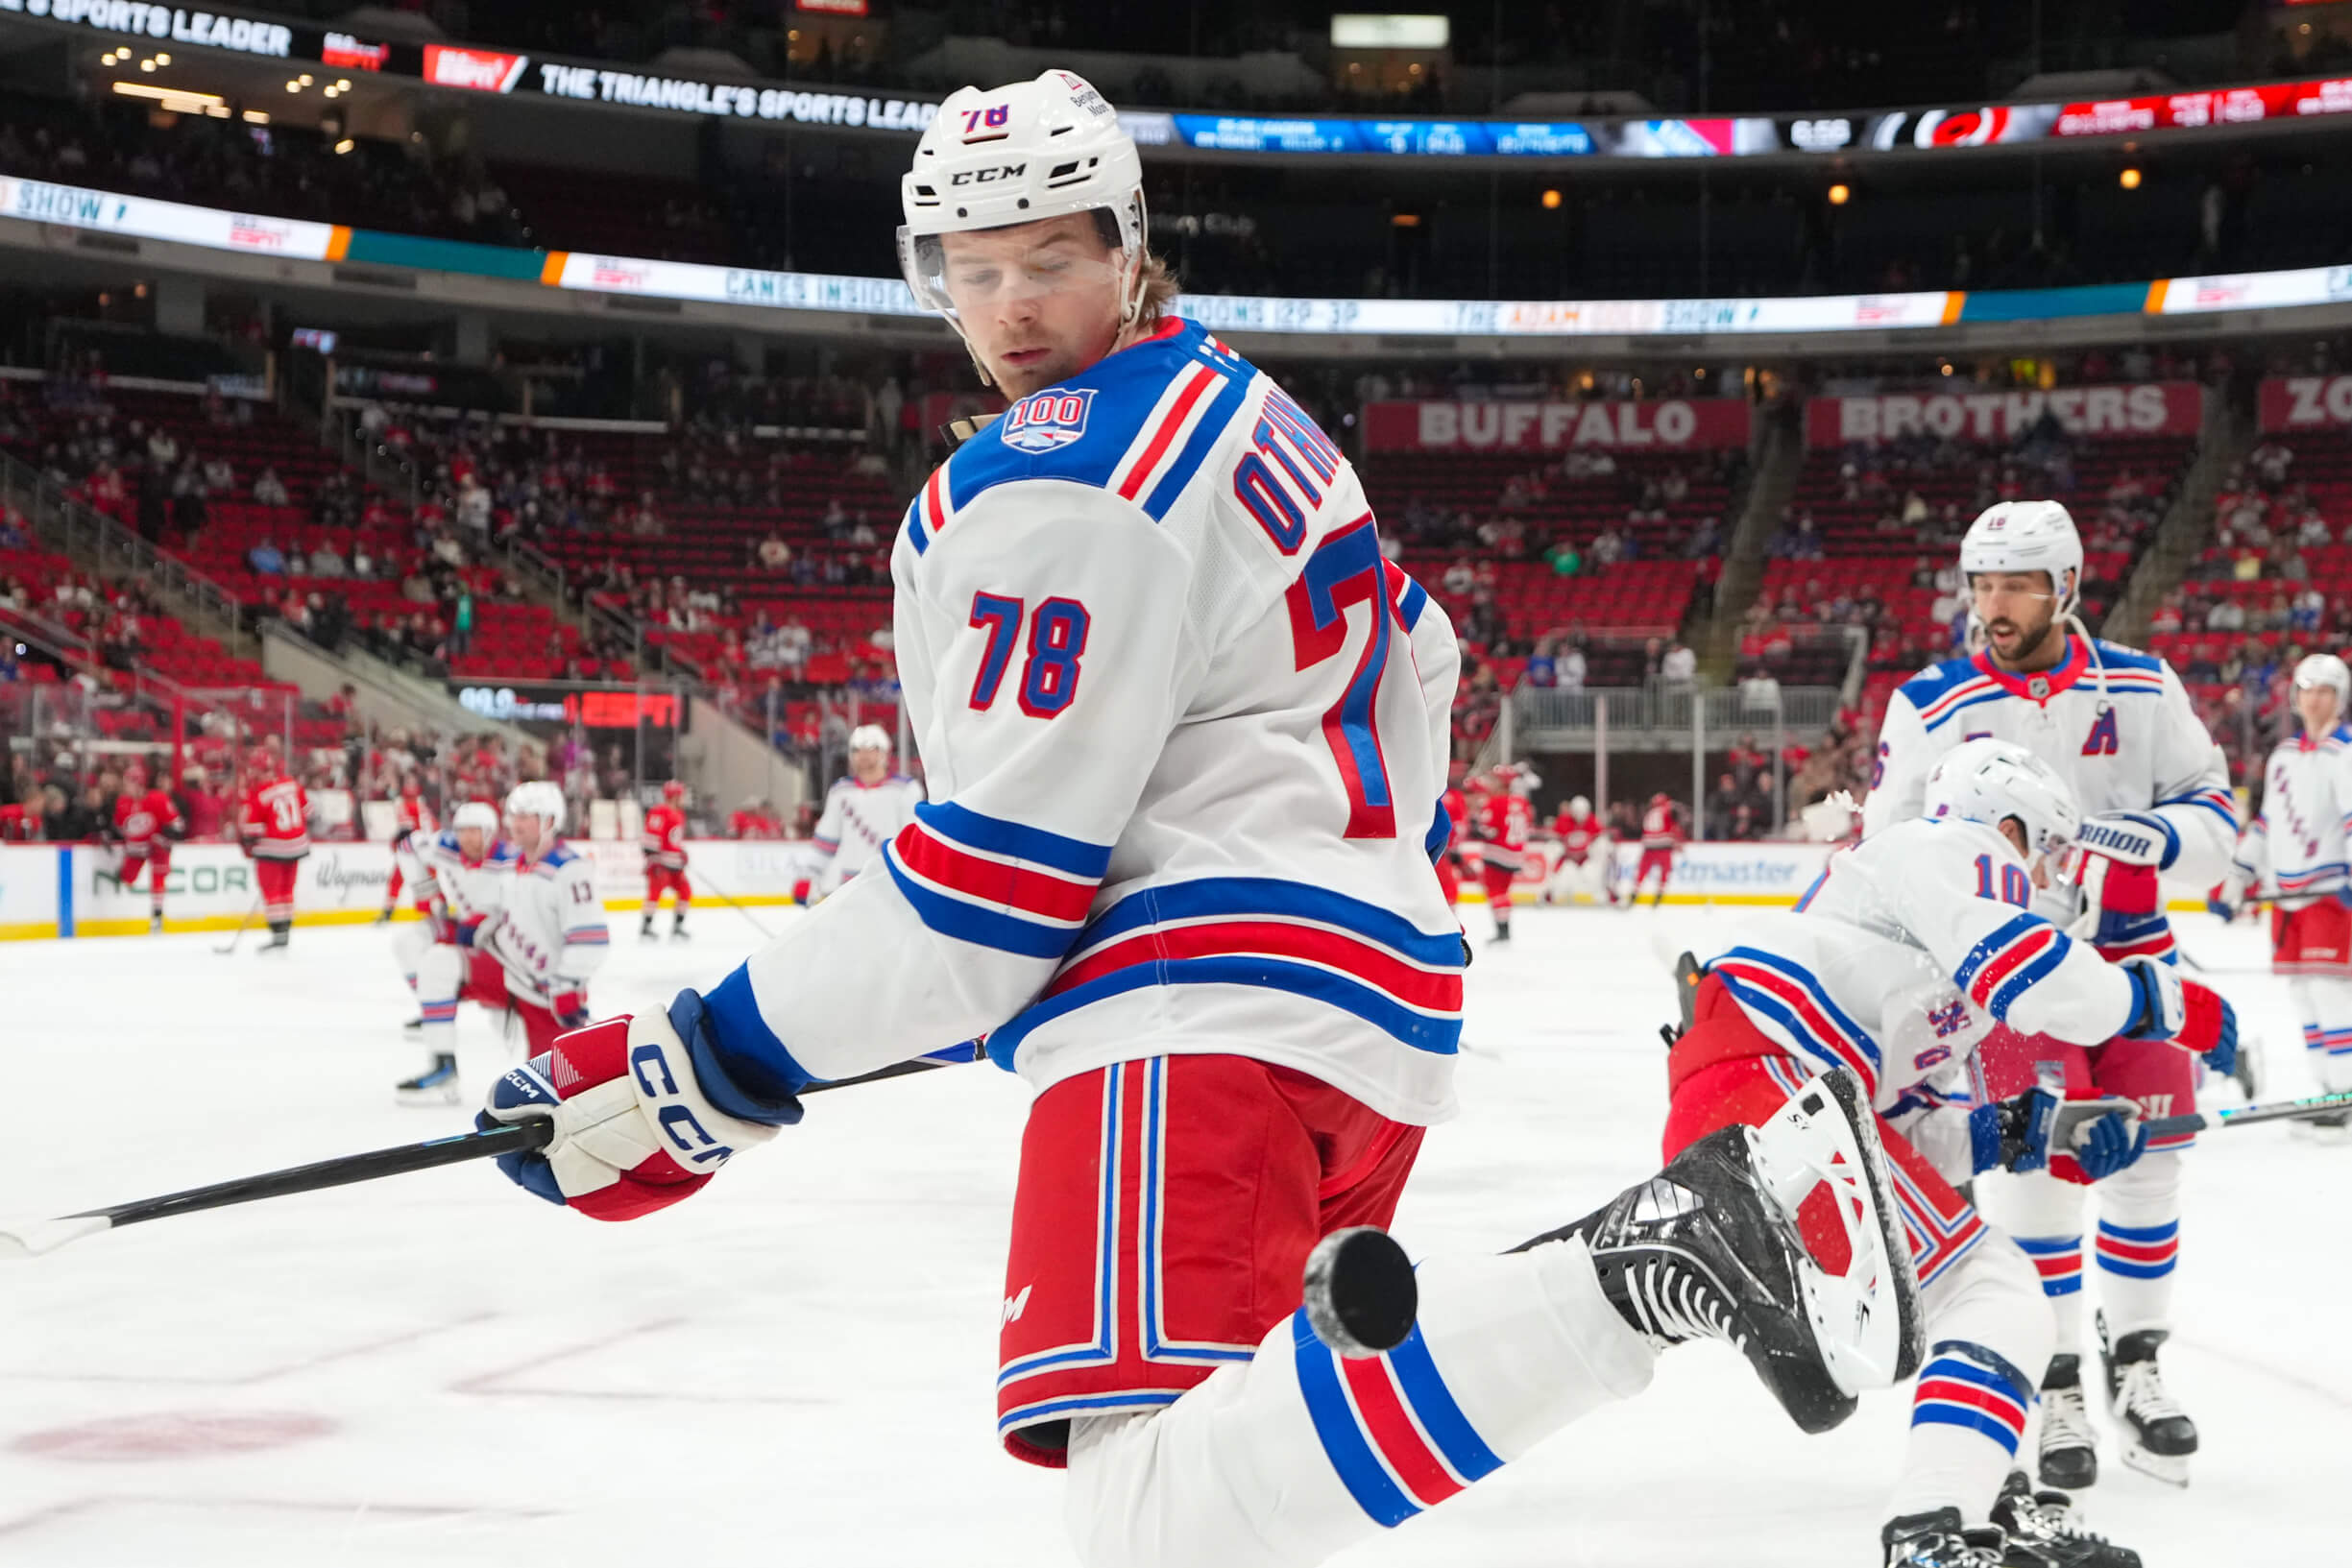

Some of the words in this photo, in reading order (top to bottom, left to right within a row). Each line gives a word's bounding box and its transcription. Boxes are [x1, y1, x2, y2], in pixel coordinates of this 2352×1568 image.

[172, 9, 292, 58] LEADER
[540, 63, 597, 99] THE
[599, 72, 757, 117] TRIANGLE'S
[758, 88, 866, 127] SPORTS
[961, 104, 1008, 133] 78
[951, 163, 1027, 186] CCM
[17, 181, 101, 220] SHOW
[1007, 396, 1084, 431] 100
[1418, 401, 1697, 446] BUFFALO
[1840, 385, 2169, 438] BROTHERS
[968, 591, 1091, 720] 78
[2080, 706, 2120, 756] A
[1974, 853, 2031, 910] 10
[505, 1071, 540, 1098] CCM
